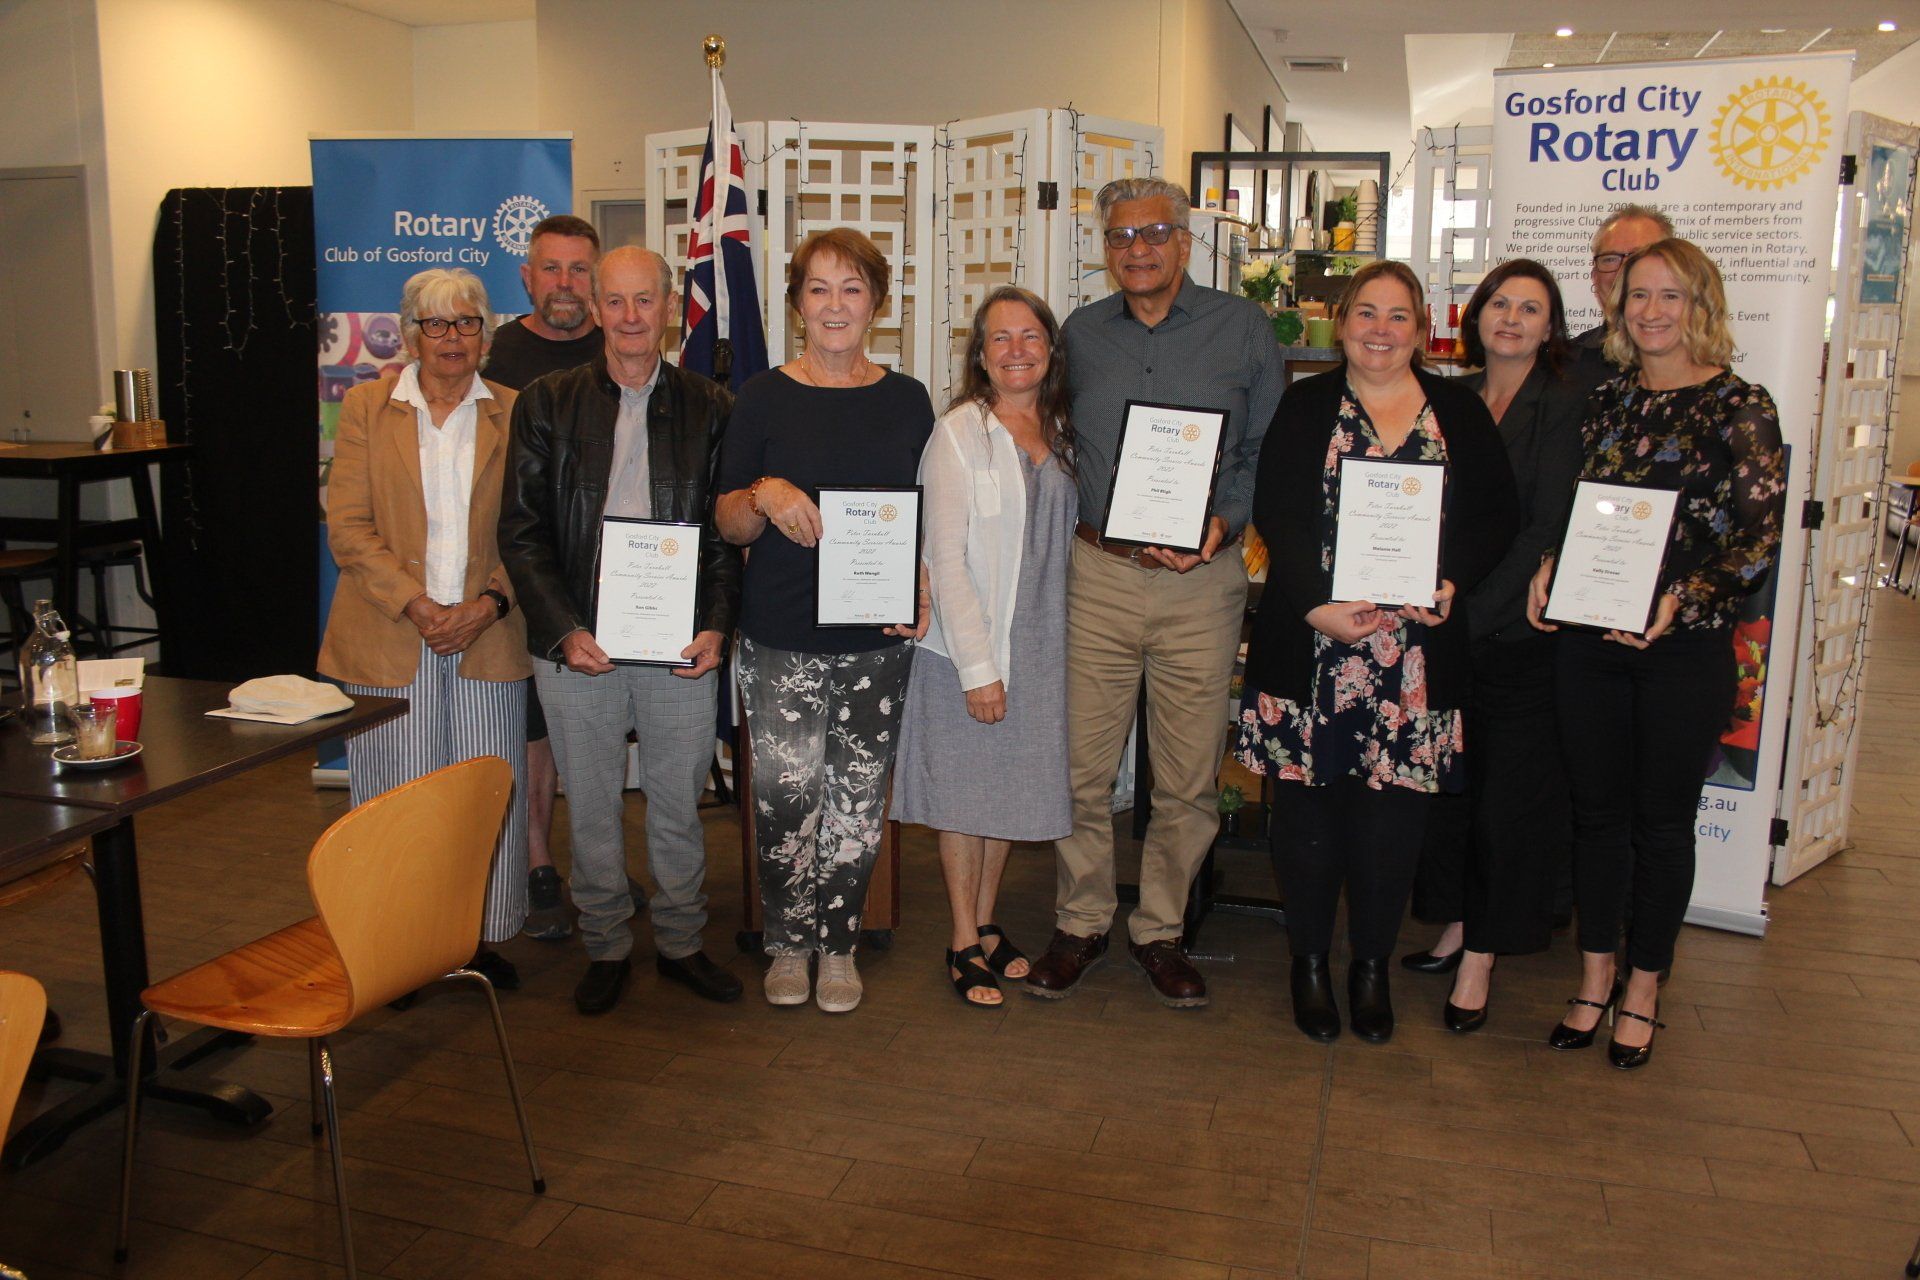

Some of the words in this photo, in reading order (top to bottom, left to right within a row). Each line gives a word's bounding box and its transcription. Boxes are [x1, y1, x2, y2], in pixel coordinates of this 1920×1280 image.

[1505, 88, 1626, 116] Gosford
[1637, 85, 1702, 118] City
[1746, 88, 1797, 104] ROTARY
[1529, 122, 1699, 172] Rotary
[1601, 168, 1660, 192] Club
[1516, 203, 1562, 213] Founded
[1566, 203, 1575, 212] in
[1578, 203, 1604, 213] June
[1661, 203, 1679, 212] are
[1683, 204, 1689, 212] a
[1693, 202, 1776, 215] contemporary
[1779, 201, 1803, 211] and
[394, 211, 487, 242] Rotary
[1514, 217, 1575, 228] progressive
[1675, 217, 1696, 226] mix
[1700, 216, 1712, 225] of
[1714, 216, 1769, 225] members
[1773, 215, 1802, 225] from
[1512, 230, 1529, 239] the
[1532, 230, 1594, 242] community
[1712, 230, 1753, 240] service
[1756, 231, 1802, 240] sectors.
[1506, 243, 1522, 253] We
[1525, 243, 1553, 254] pride
[1705, 245, 1748, 254] women
[1751, 244, 1762, 253] in
[1766, 244, 1808, 256] Rotary.
[324, 247, 358, 262] Club
[363, 247, 382, 262] of
[386, 247, 453, 263] Gosford
[459, 248, 490, 266] City
[1537, 257, 1585, 267] ourselves
[1729, 258, 1789, 268] influential
[1793, 258, 1815, 268] and
[1557, 272, 1580, 283] part
[1741, 273, 1811, 285] community.
[1565, 308, 1585, 317] ited
[1737, 312, 1770, 321] Event
[1151, 425, 1180, 436] Rotary
[1368, 479, 1399, 490] Rotary
[846, 508, 876, 518] Rotary
[628, 540, 658, 551] Rotary
[1699, 823, 1731, 842] city
